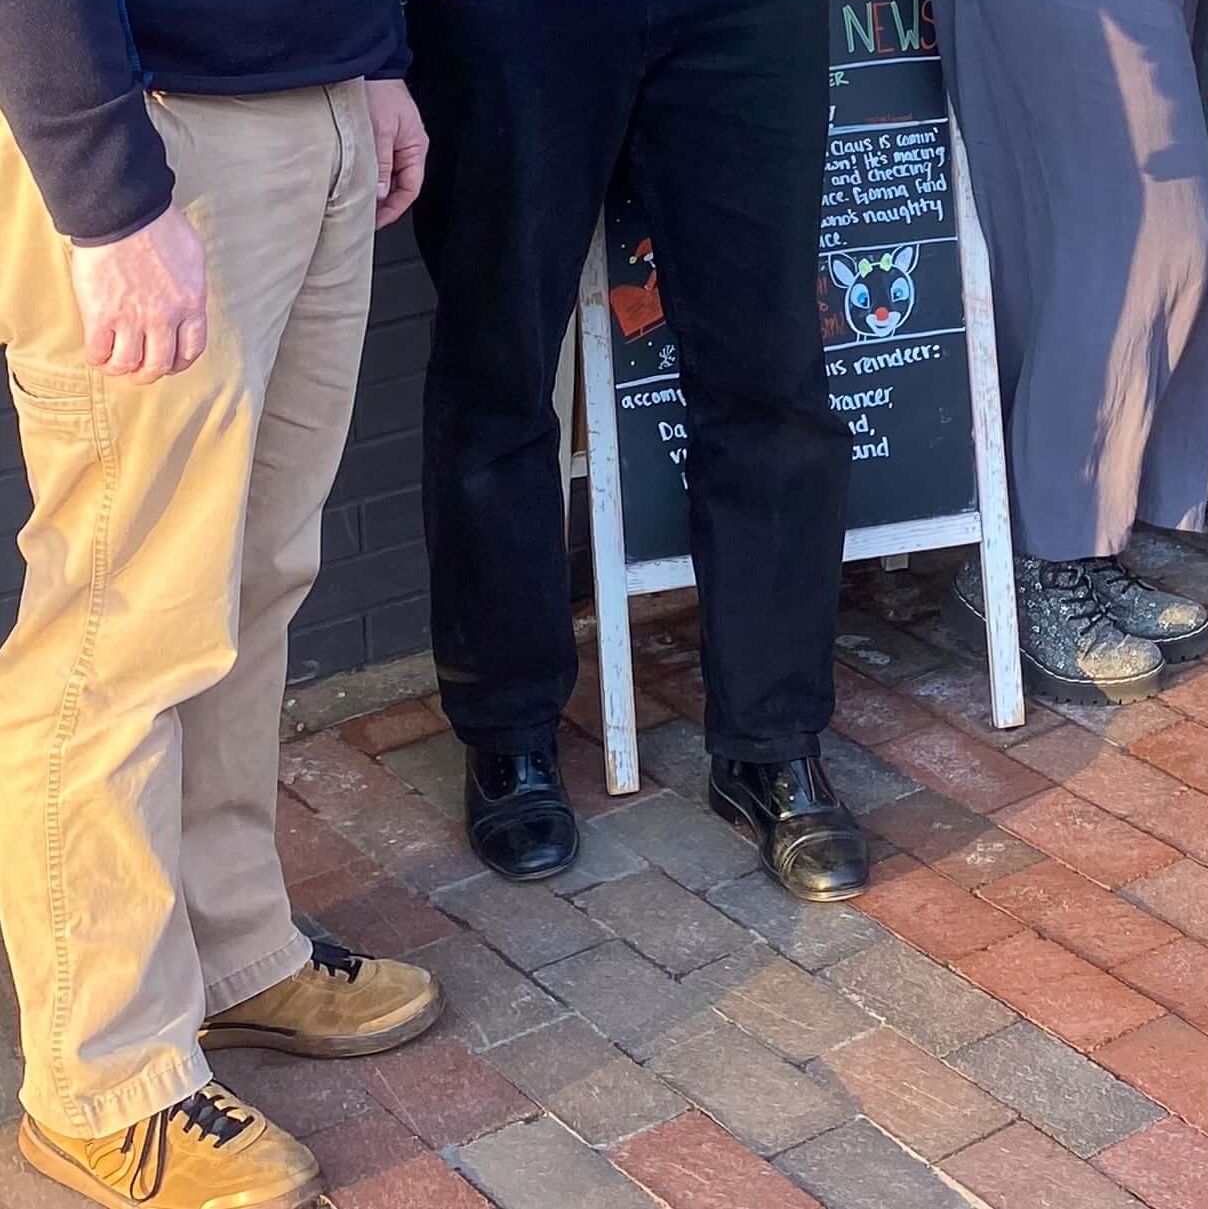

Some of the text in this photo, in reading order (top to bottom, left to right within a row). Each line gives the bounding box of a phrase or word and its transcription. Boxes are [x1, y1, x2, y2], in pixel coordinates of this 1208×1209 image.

[830, 138, 873, 155] Claus
[864, 151, 888, 170] He's
[831, 169, 862, 186] and
[852, 186, 909, 204] Gonna
[863, 198, 943, 224] naughty
[854, 344, 941, 375] reindeer:
[658, 421, 688, 441] Da
